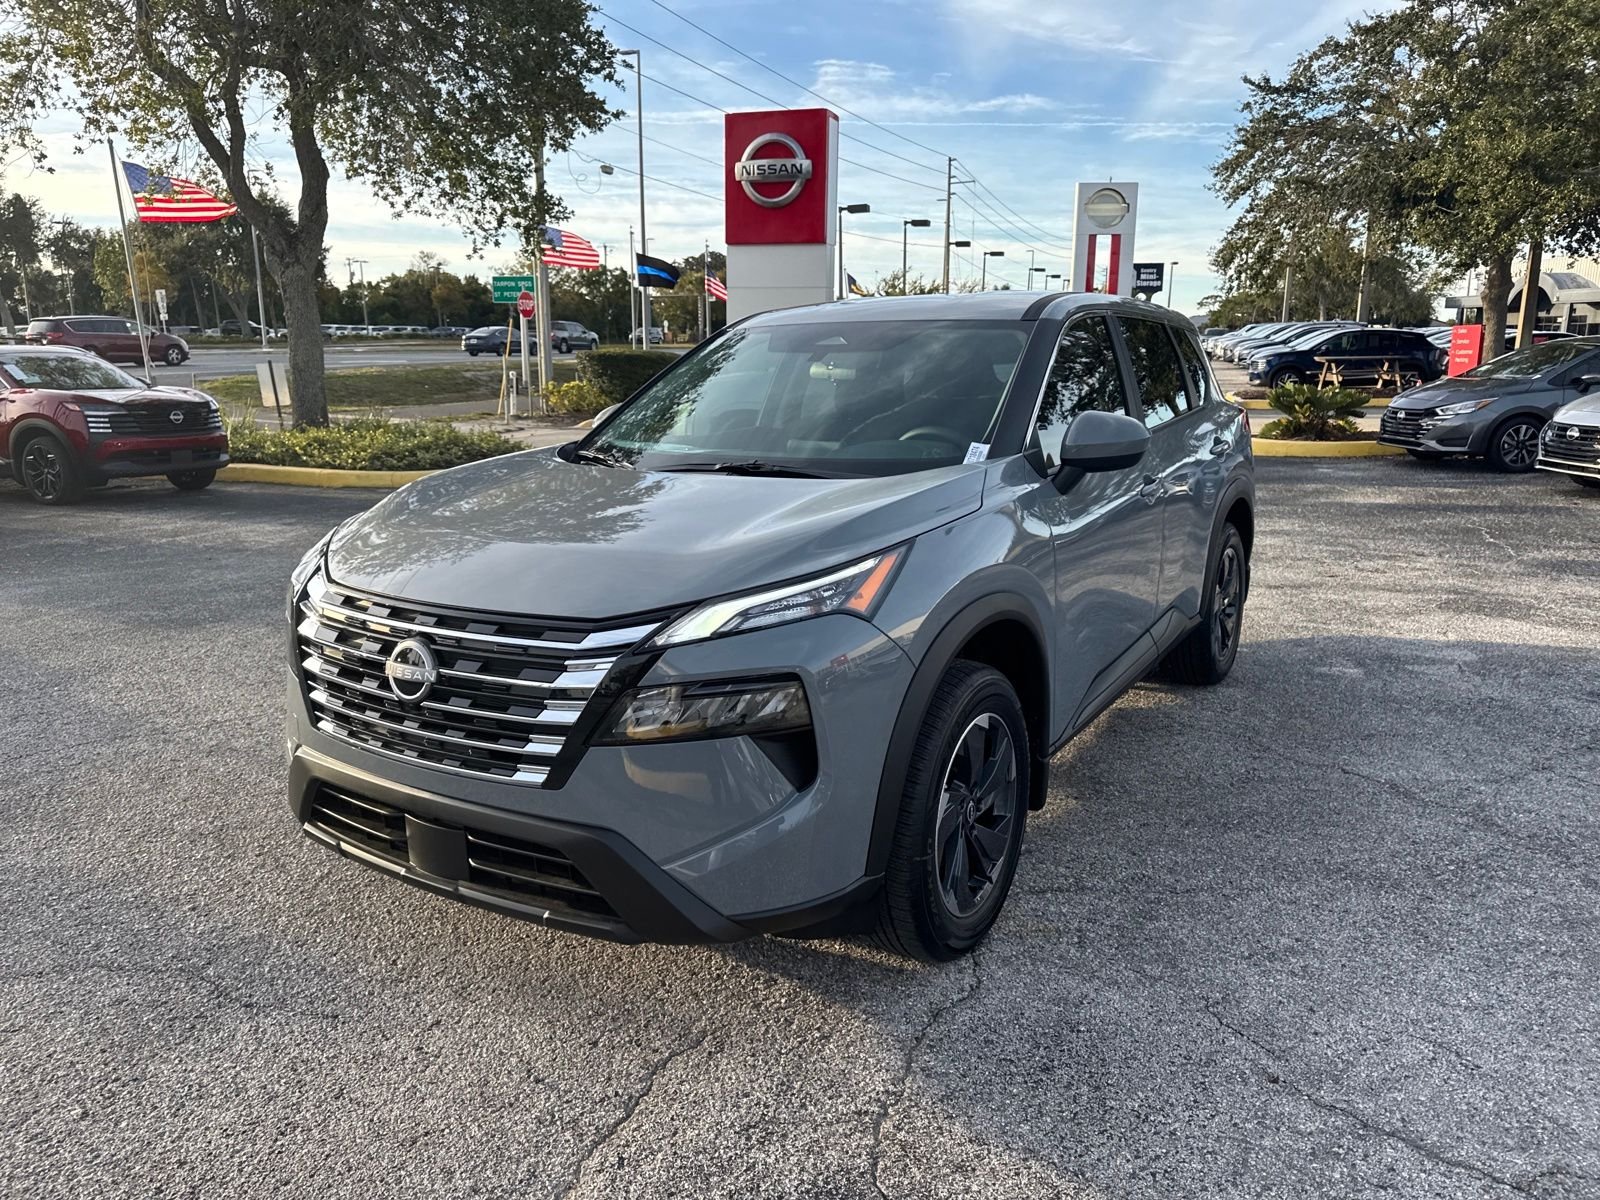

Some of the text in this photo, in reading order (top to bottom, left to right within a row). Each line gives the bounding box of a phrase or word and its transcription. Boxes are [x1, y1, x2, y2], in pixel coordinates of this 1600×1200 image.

[741, 163, 803, 177] NISSAN
[519, 299, 534, 310] STOP
[387, 662, 435, 681] NISSAN
